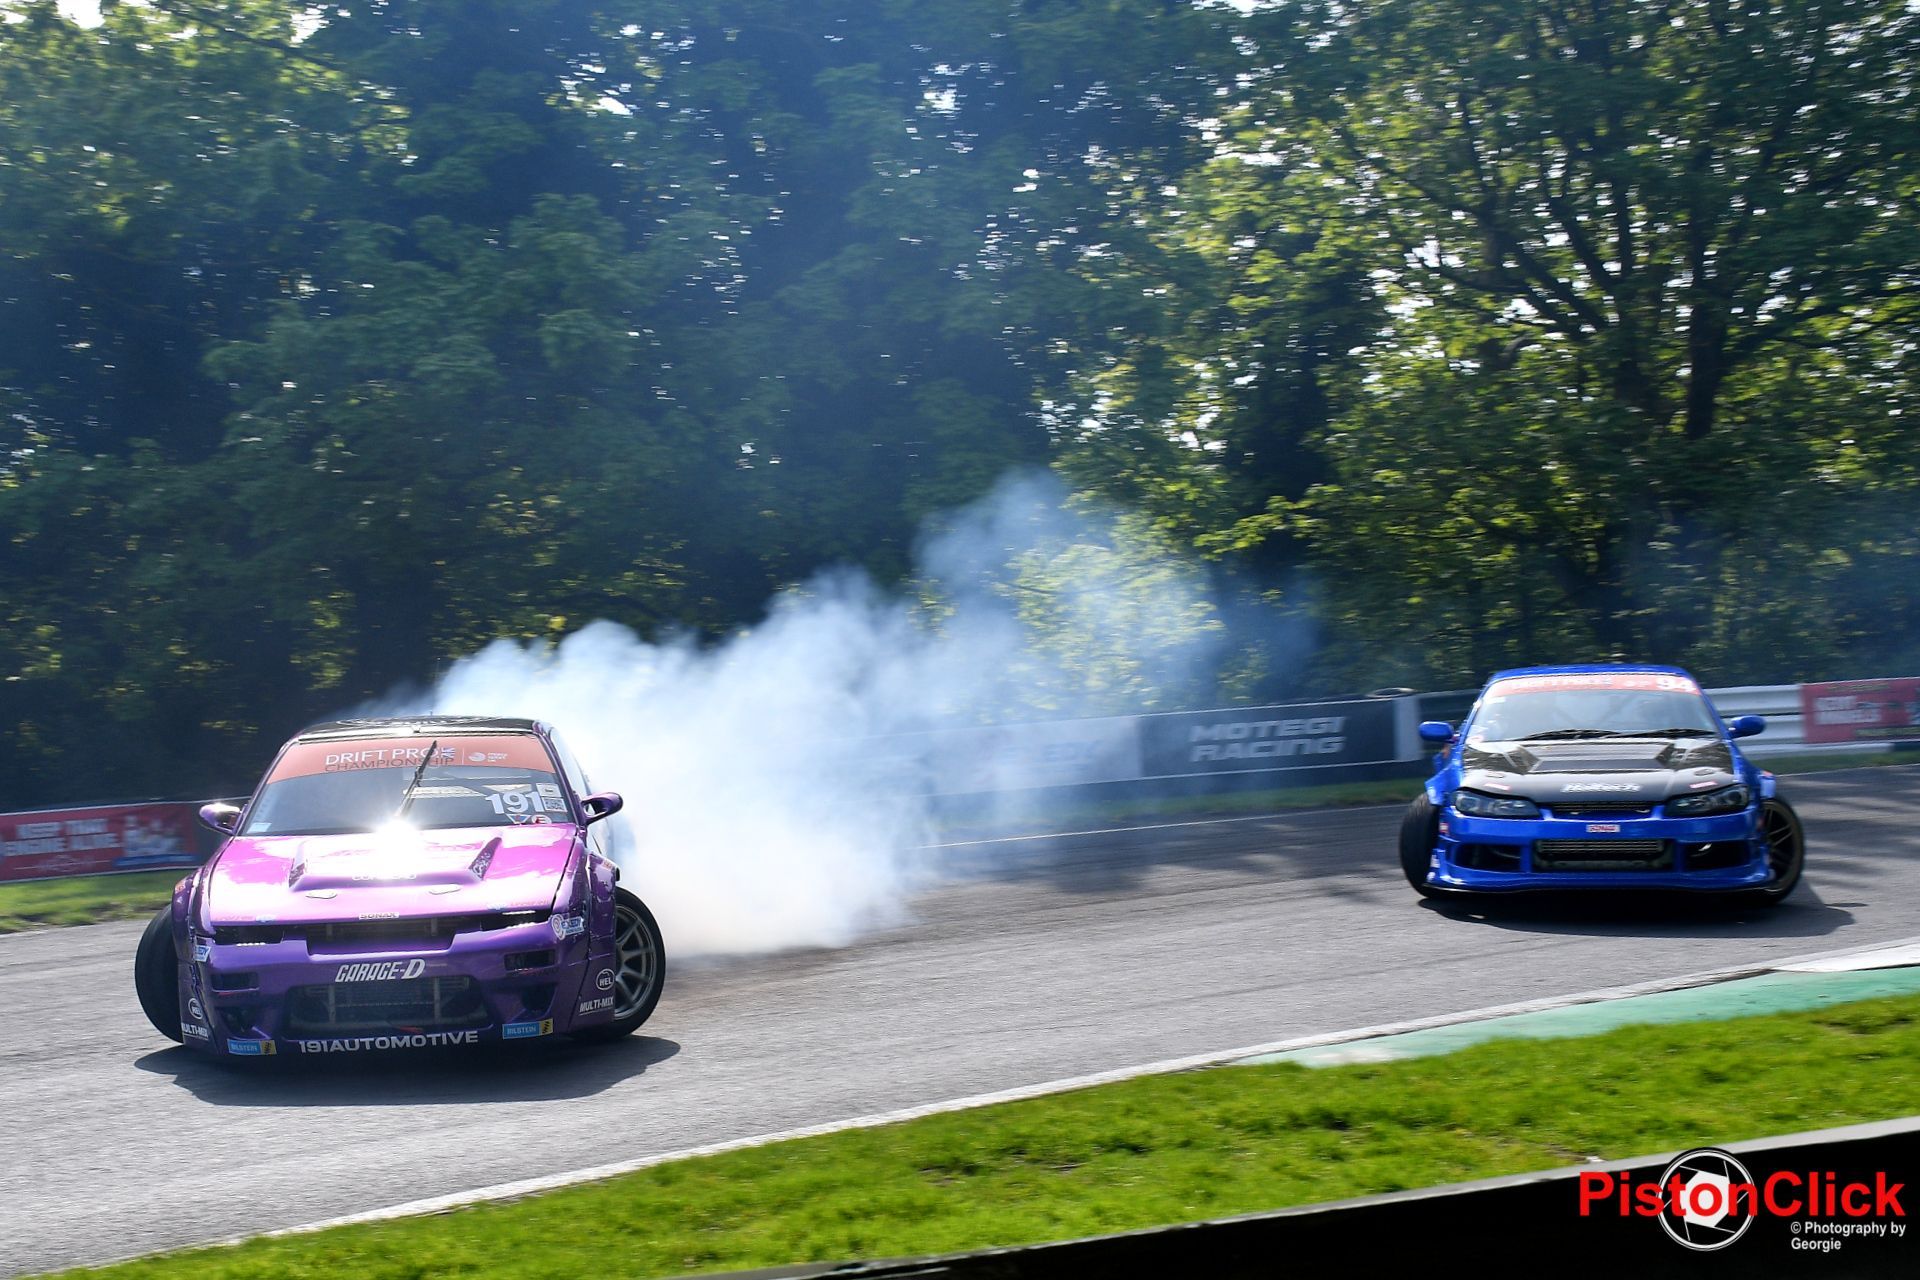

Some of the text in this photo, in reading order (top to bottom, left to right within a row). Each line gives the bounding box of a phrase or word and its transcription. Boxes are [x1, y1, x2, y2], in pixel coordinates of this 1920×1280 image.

[1190, 716, 1346, 742] MOTEGI
[325, 749, 389, 766] DRIFT
[1189, 736, 1346, 762] RACING
[485, 791, 546, 815] 191
[334, 958, 426, 983] GARAGE-D
[579, 996, 614, 1013] MULTI-MIX
[298, 1030, 479, 1054] 191AUTOMOTIVE
